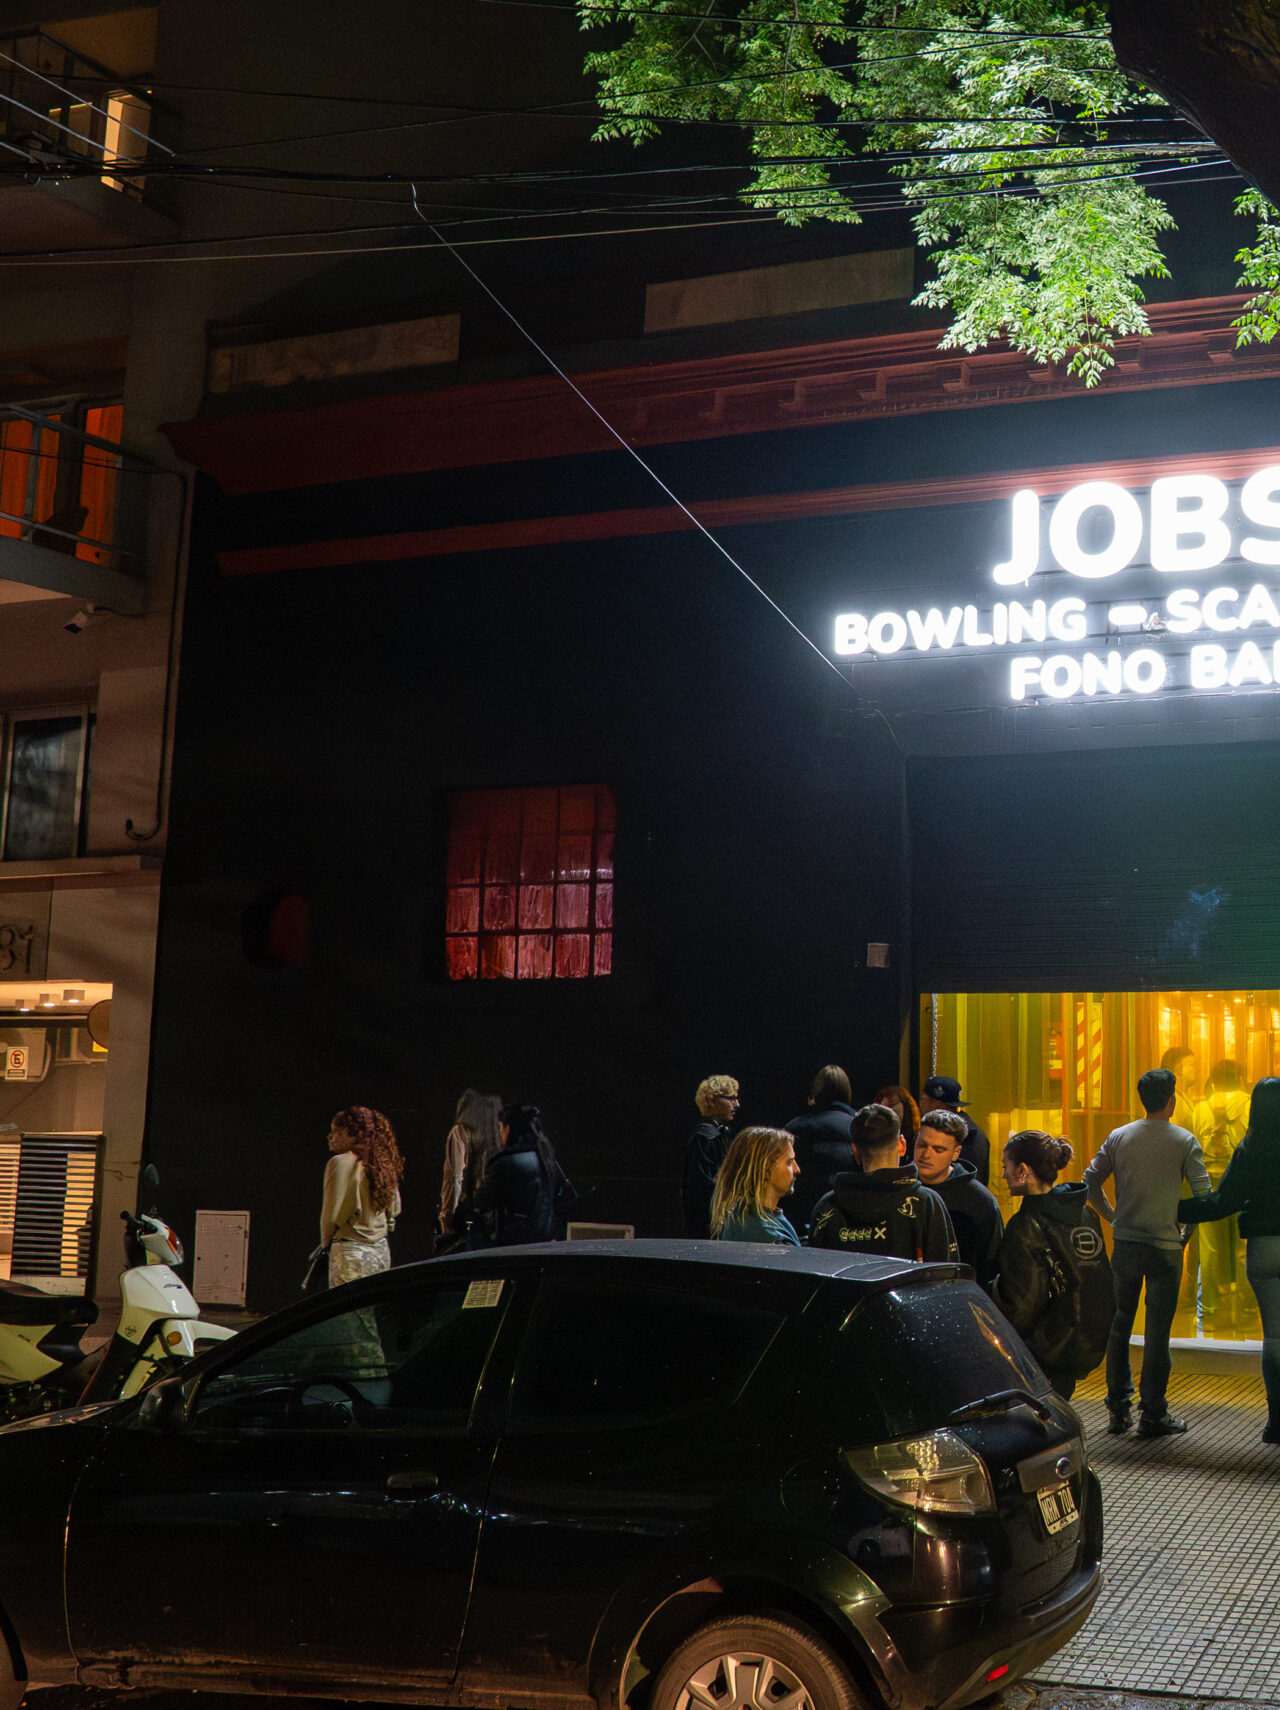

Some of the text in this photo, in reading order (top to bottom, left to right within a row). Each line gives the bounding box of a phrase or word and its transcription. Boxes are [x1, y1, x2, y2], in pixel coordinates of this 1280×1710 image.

[834, 597, 1087, 655] BOWLING
[1010, 649, 1167, 701] FONO
[1057, 1486, 1076, 1516] 704
